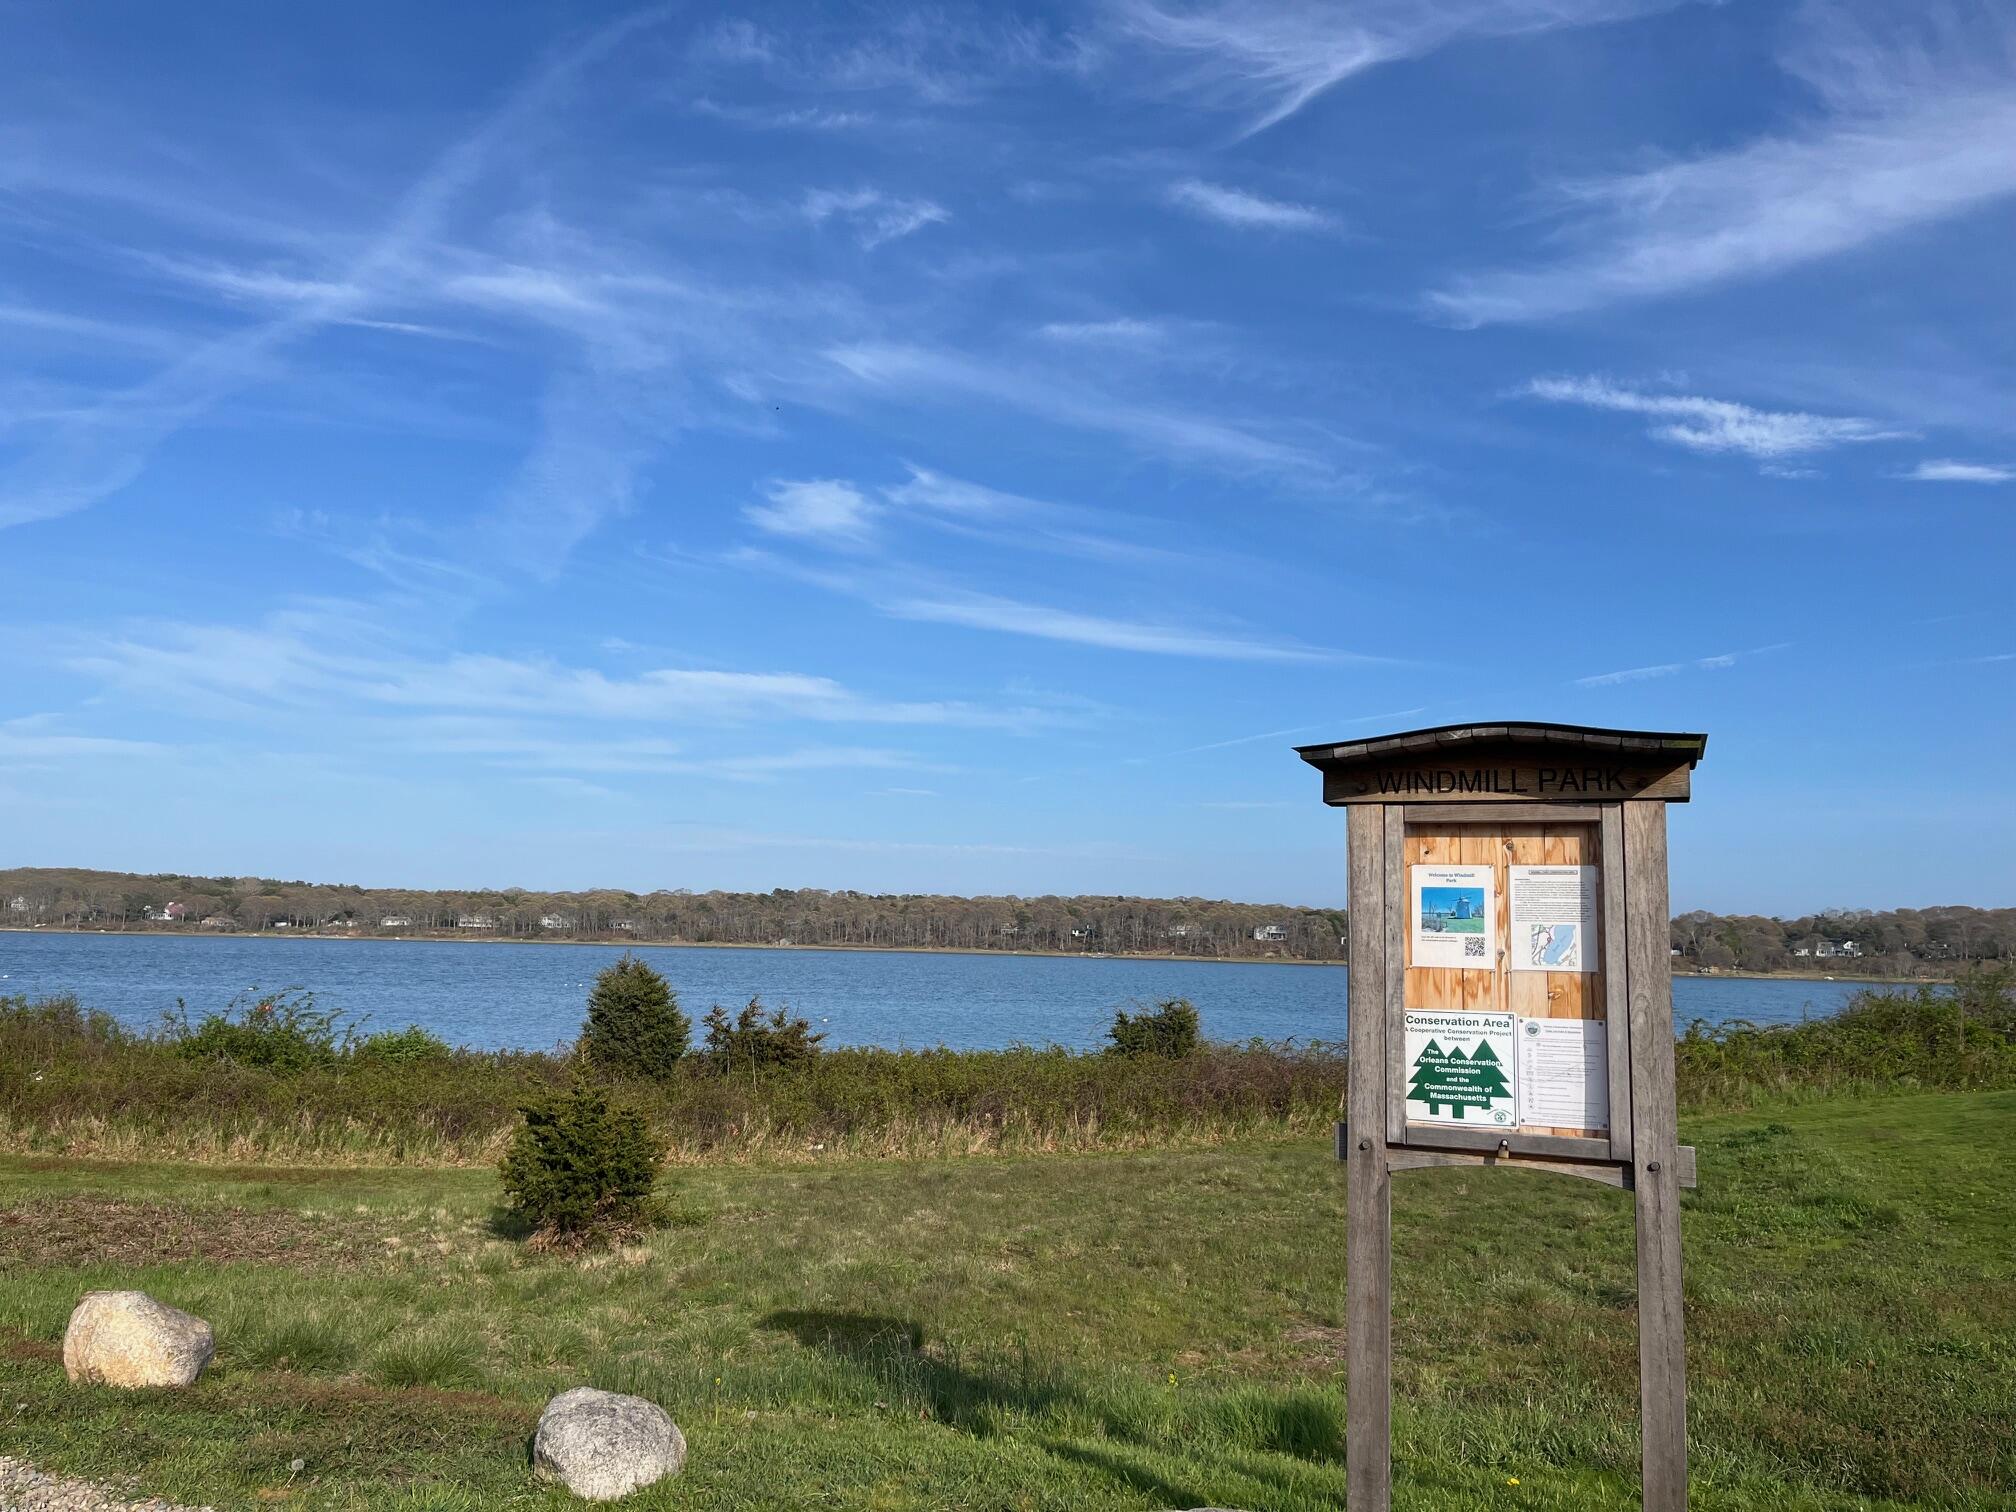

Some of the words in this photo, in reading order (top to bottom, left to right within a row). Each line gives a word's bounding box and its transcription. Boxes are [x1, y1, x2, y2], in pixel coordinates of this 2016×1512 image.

[1377, 769, 1527, 794] WINDMILL
[1538, 767, 1626, 792] PARK
[1405, 1015, 1480, 1026] Conservation
[1483, 1018, 1510, 1028] Area
[1447, 1028, 1488, 1036] Conservation
[1450, 1057, 1501, 1067] Conservation
[1435, 1066, 1481, 1075] Commission
[1424, 1083, 1483, 1093] Commonwealth
[1430, 1092, 1487, 1102] Massachusetts
